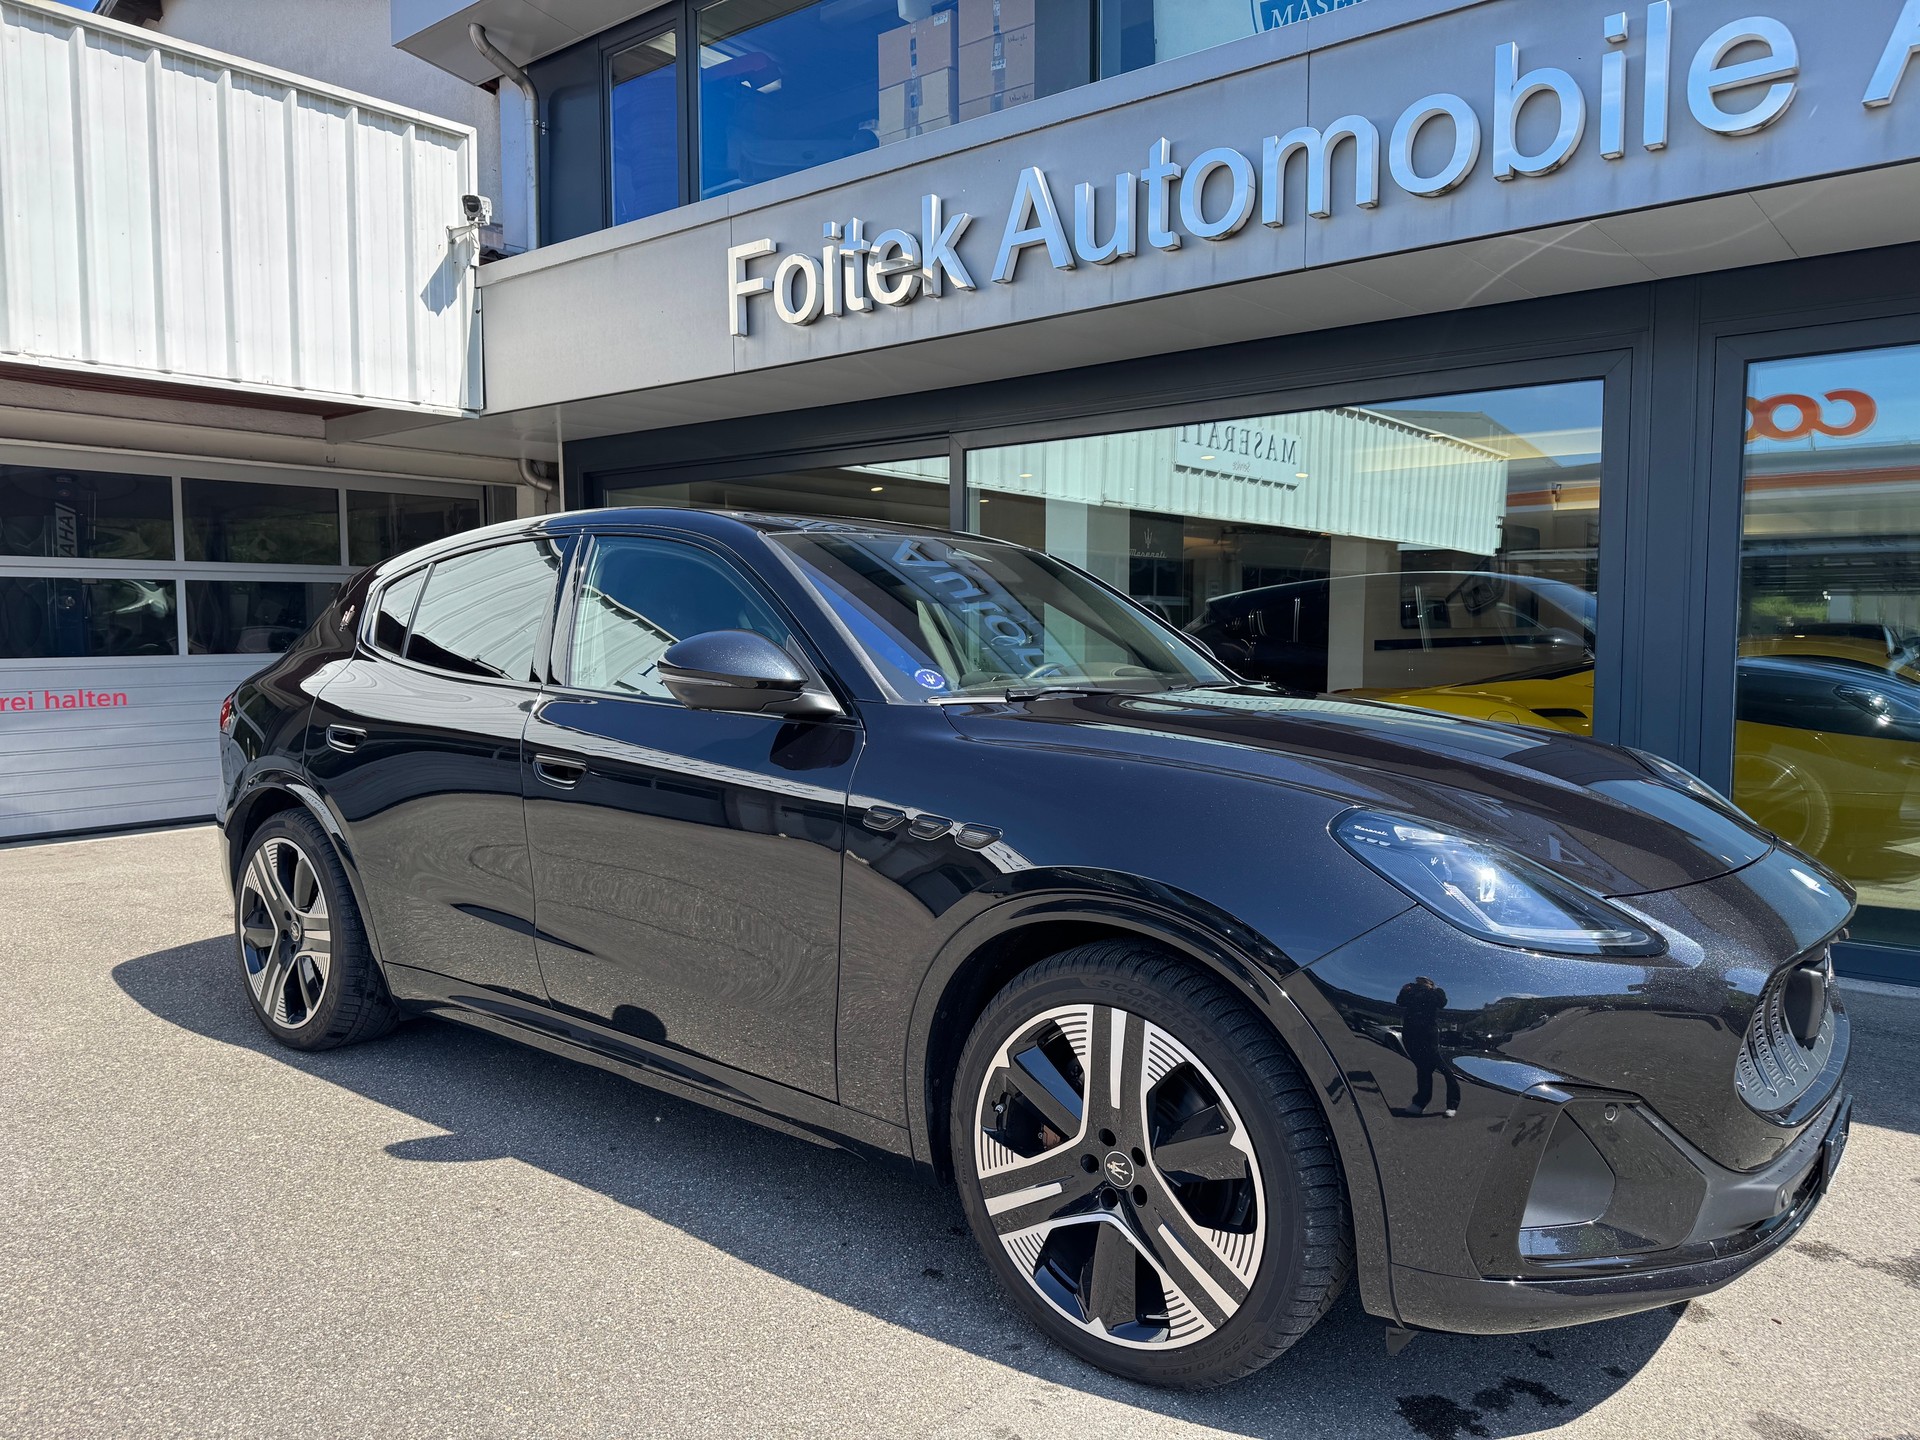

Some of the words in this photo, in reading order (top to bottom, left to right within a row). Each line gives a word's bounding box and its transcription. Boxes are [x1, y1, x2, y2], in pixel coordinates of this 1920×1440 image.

[728, 194, 977, 337] Foitek
[992, 1, 1799, 284] Automobile
[0, 691, 33, 711] rei
[44, 689, 127, 709] halten
[1097, 979, 1217, 1043] SCORPION
